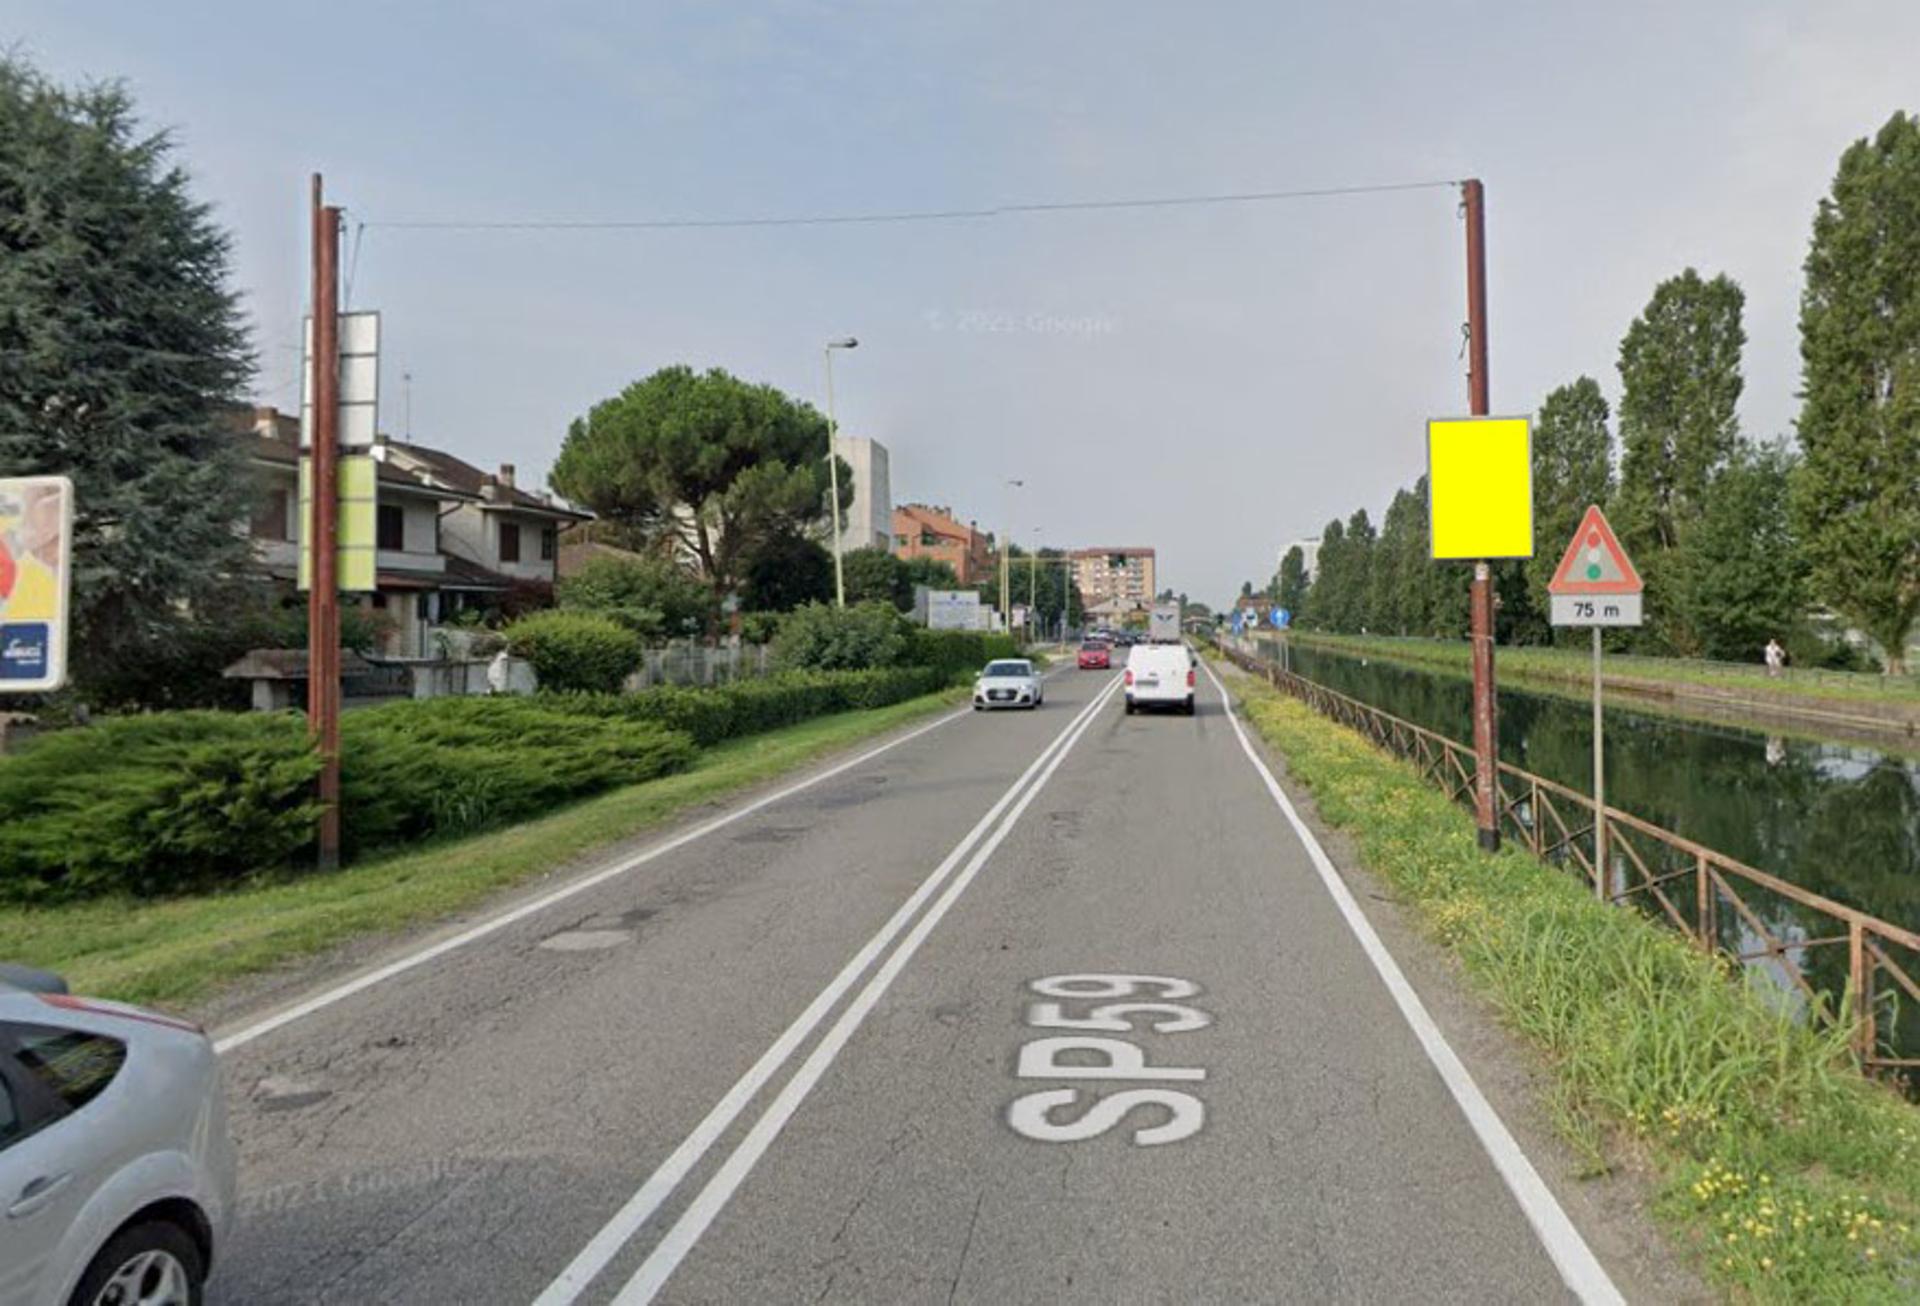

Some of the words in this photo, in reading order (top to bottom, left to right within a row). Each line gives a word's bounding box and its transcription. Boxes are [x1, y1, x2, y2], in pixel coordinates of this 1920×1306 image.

[1574, 602, 1595, 617] 75
[1604, 605, 1620, 617] m
[1009, 974, 1211, 1146] SP59
